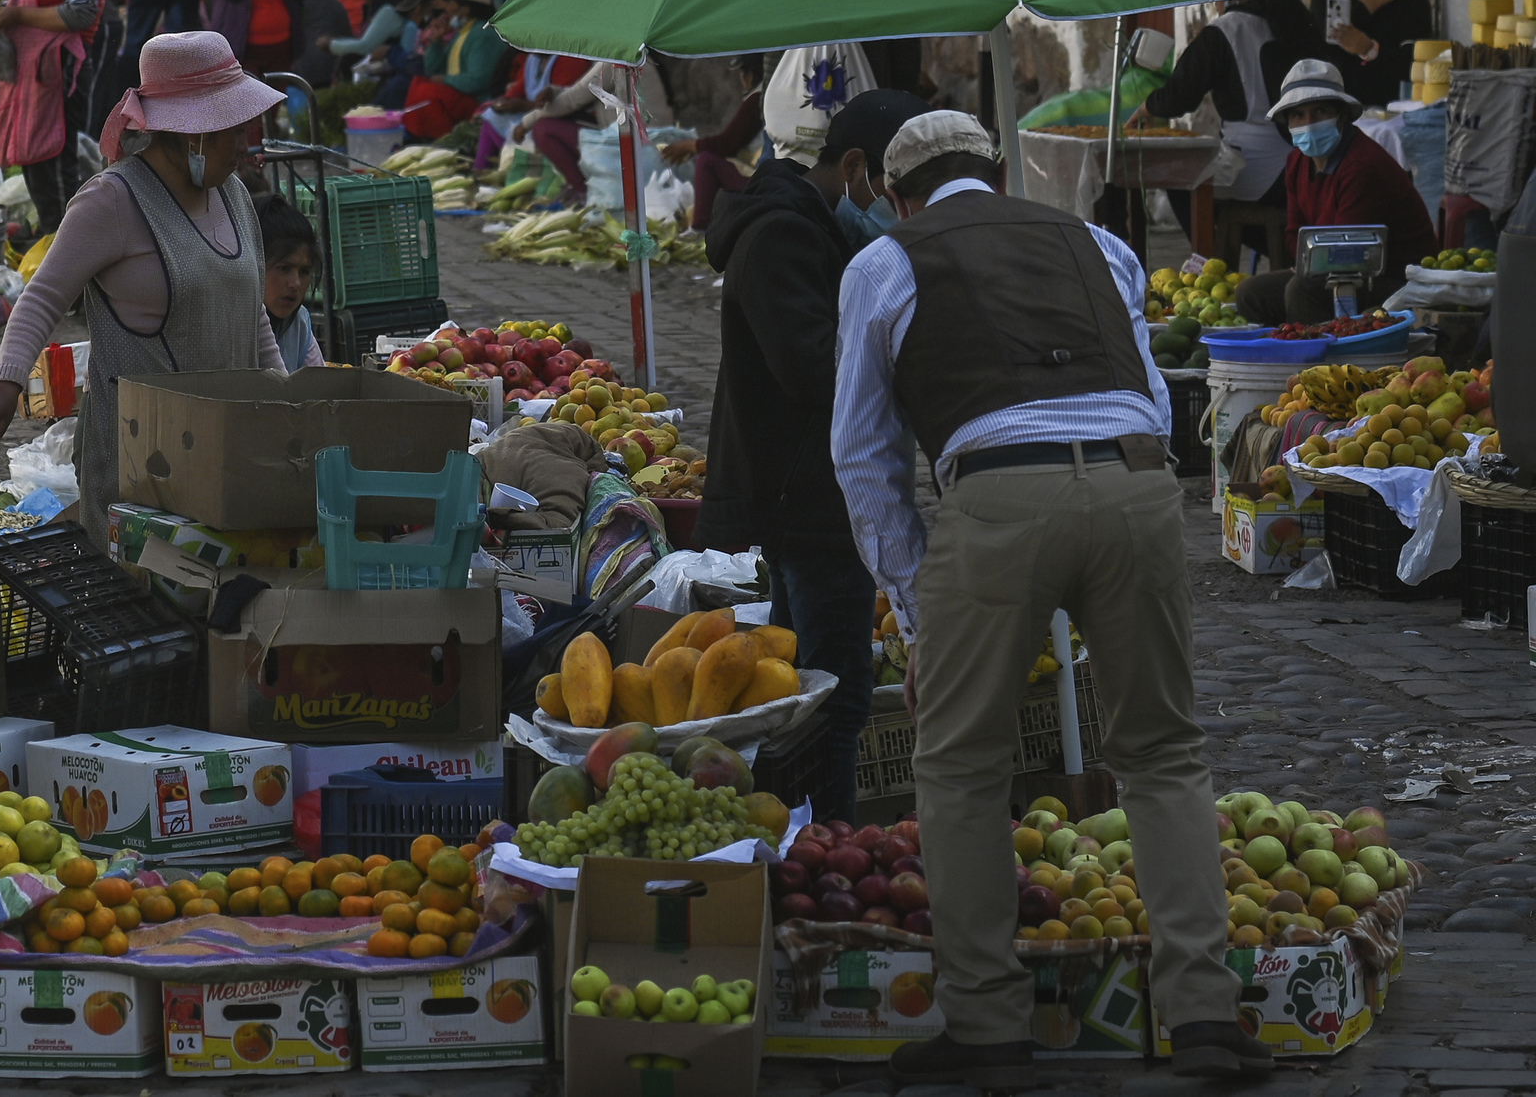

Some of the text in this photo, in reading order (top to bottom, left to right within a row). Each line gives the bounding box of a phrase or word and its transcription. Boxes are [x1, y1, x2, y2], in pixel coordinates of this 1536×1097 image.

[68, 768, 98, 784] HUAYCO
[127, 838, 146, 848] DIKEL
[428, 977, 476, 988] HUAYCO
[831, 1011, 863, 1019] Calidad
